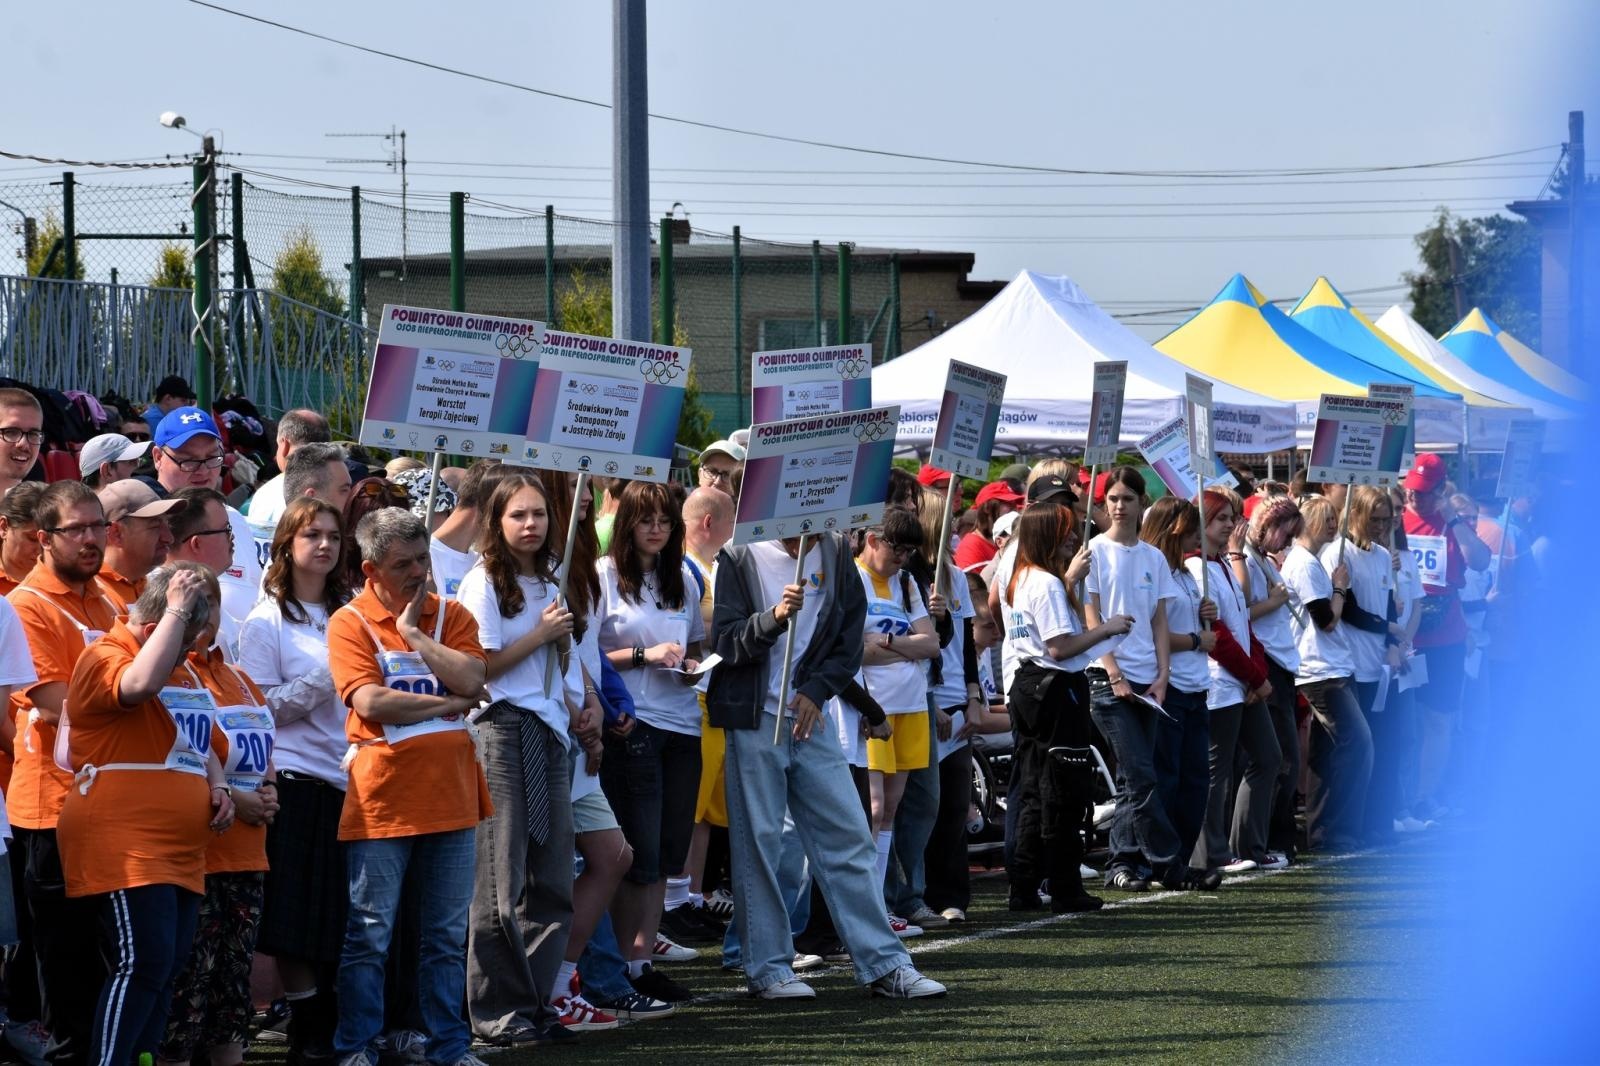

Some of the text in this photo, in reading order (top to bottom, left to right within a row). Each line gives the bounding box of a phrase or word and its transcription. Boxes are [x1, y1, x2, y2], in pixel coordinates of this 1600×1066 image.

[391, 309, 528, 336] POWIATOWA OLIMPIADA
[418, 326, 492, 341] NIEPEŁNOSPRAWNYCH
[543, 333, 672, 362] OWIATOWA OLIMPIADA
[560, 349, 636, 366] NIEPEŁNOSPRAWNYCH
[758, 349, 858, 366] POWIATOWA OLIMPIADA
[437, 398, 466, 410] Warsztat
[568, 399, 629, 417] Środowiskowy Dom
[1324, 396, 1400, 410] POWIATOWA OLIMPIADA
[419, 408, 479, 425] Terapii Zajęciowej
[574, 414, 618, 429] Samopomocy
[758, 412, 881, 438] POWIATOWA OLIMPIADA
[900, 411, 1038, 423] ębiorst ciągów
[568, 425, 604, 438] Jastrzębiu
[605, 429, 626, 442] Zdroju
[900, 426, 936, 434] naliza
[784, 480, 806, 488] Warsztat
